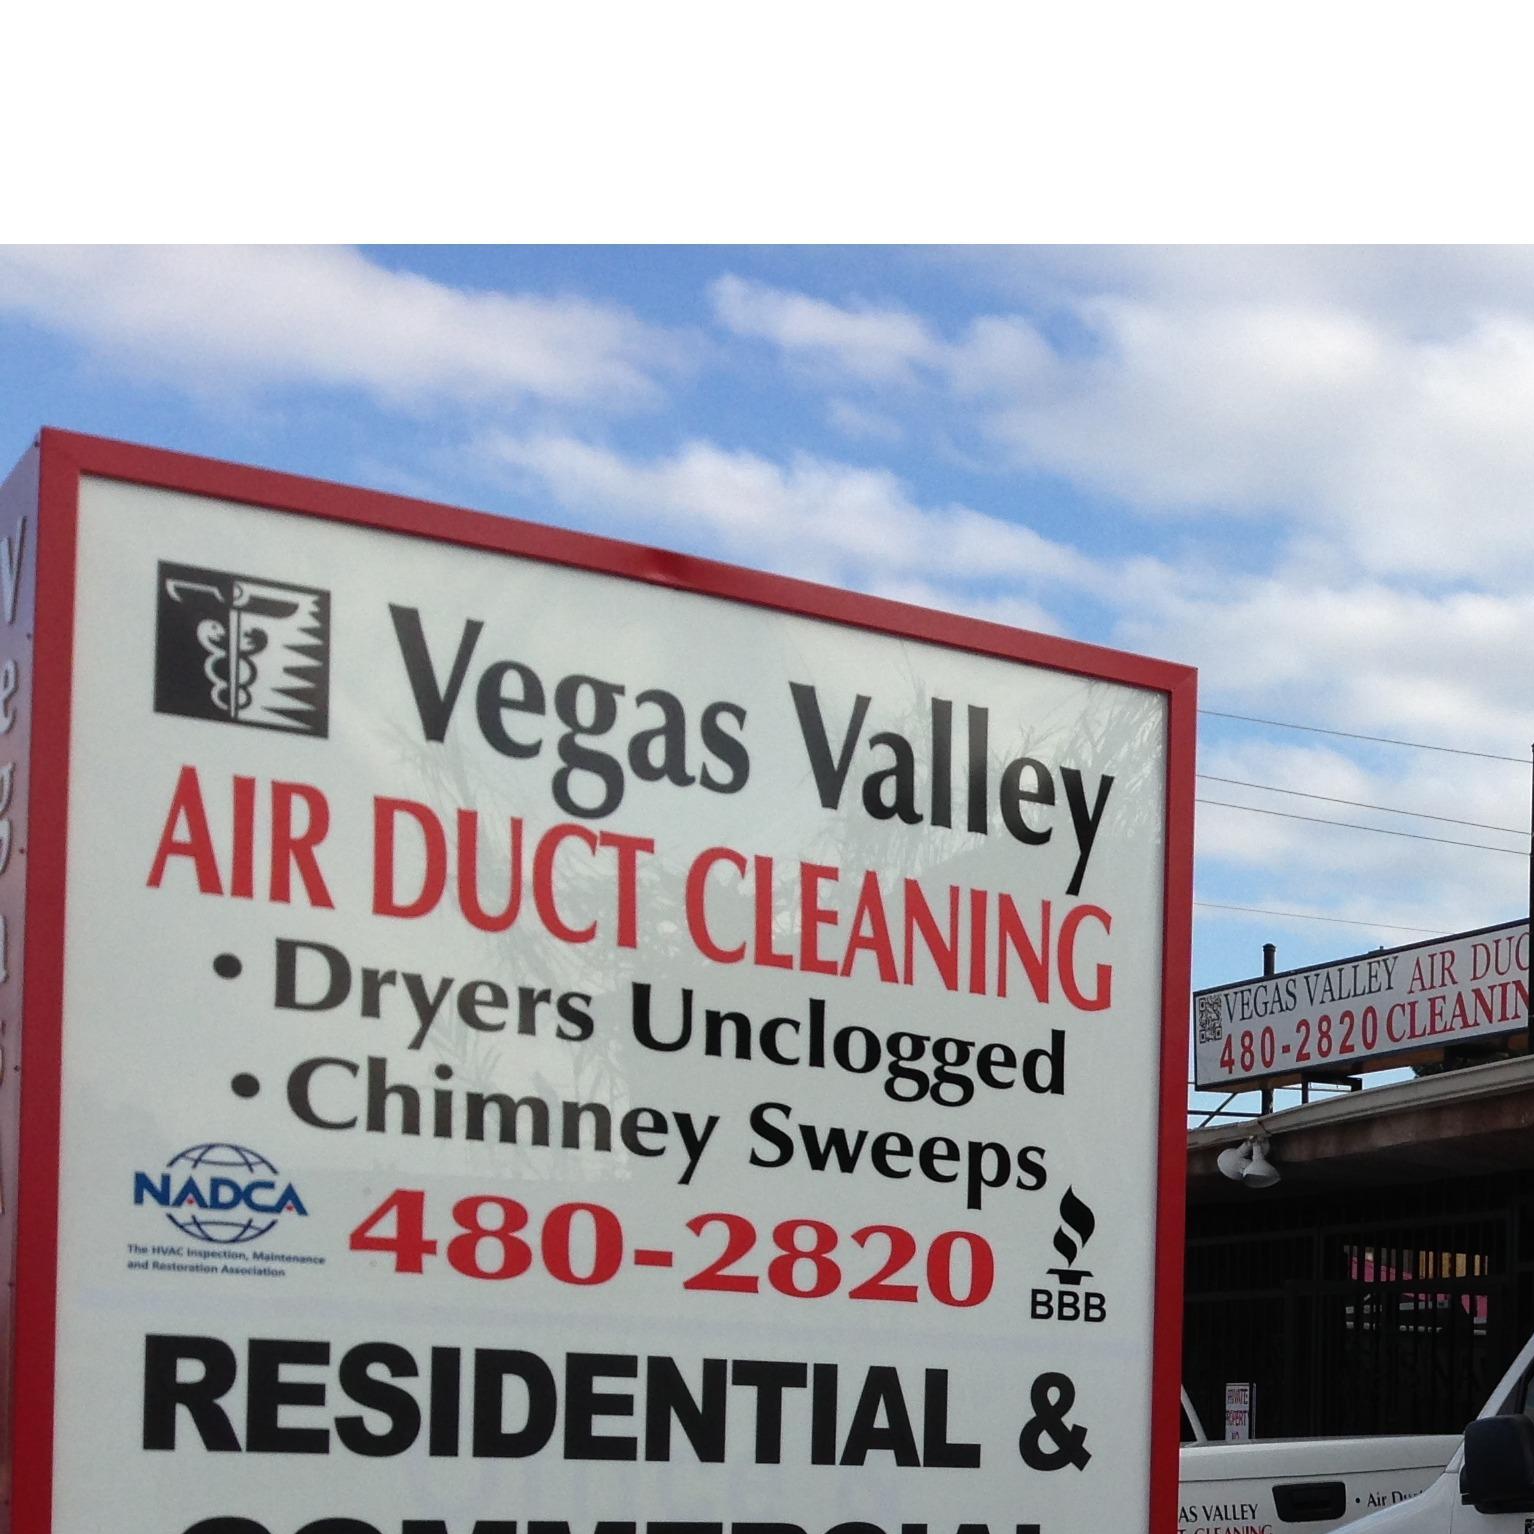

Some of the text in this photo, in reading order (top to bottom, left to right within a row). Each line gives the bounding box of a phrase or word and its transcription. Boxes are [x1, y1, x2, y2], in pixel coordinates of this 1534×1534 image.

[388, 603, 1115, 896] Vegas Valley
[146, 765, 1113, 1012] AIR DUCT CLEANING
[1224, 978, 1297, 1023] VEGAS
[1304, 956, 1398, 1006] VALLEY
[1408, 949, 1458, 994] AIR
[274, 937, 1066, 1107] Dryers Unclogged
[1220, 1006, 1377, 1074] 480-2820
[286, 1056, 1048, 1210] Chimney Sweeps
[134, 1171, 308, 1216] NADCA
[127, 1244, 326, 1265] The HVAC Inspection, Maintenance
[127, 1261, 286, 1277] and Restoration Association
[349, 1188, 995, 1307] 480-2820
[1031, 1288, 1107, 1323] BBB
[143, 1334, 1092, 1471] RESIDENTIAL &
[1202, 1504, 1258, 1521] VALLEY
[1367, 1491, 1387, 1508] Air
